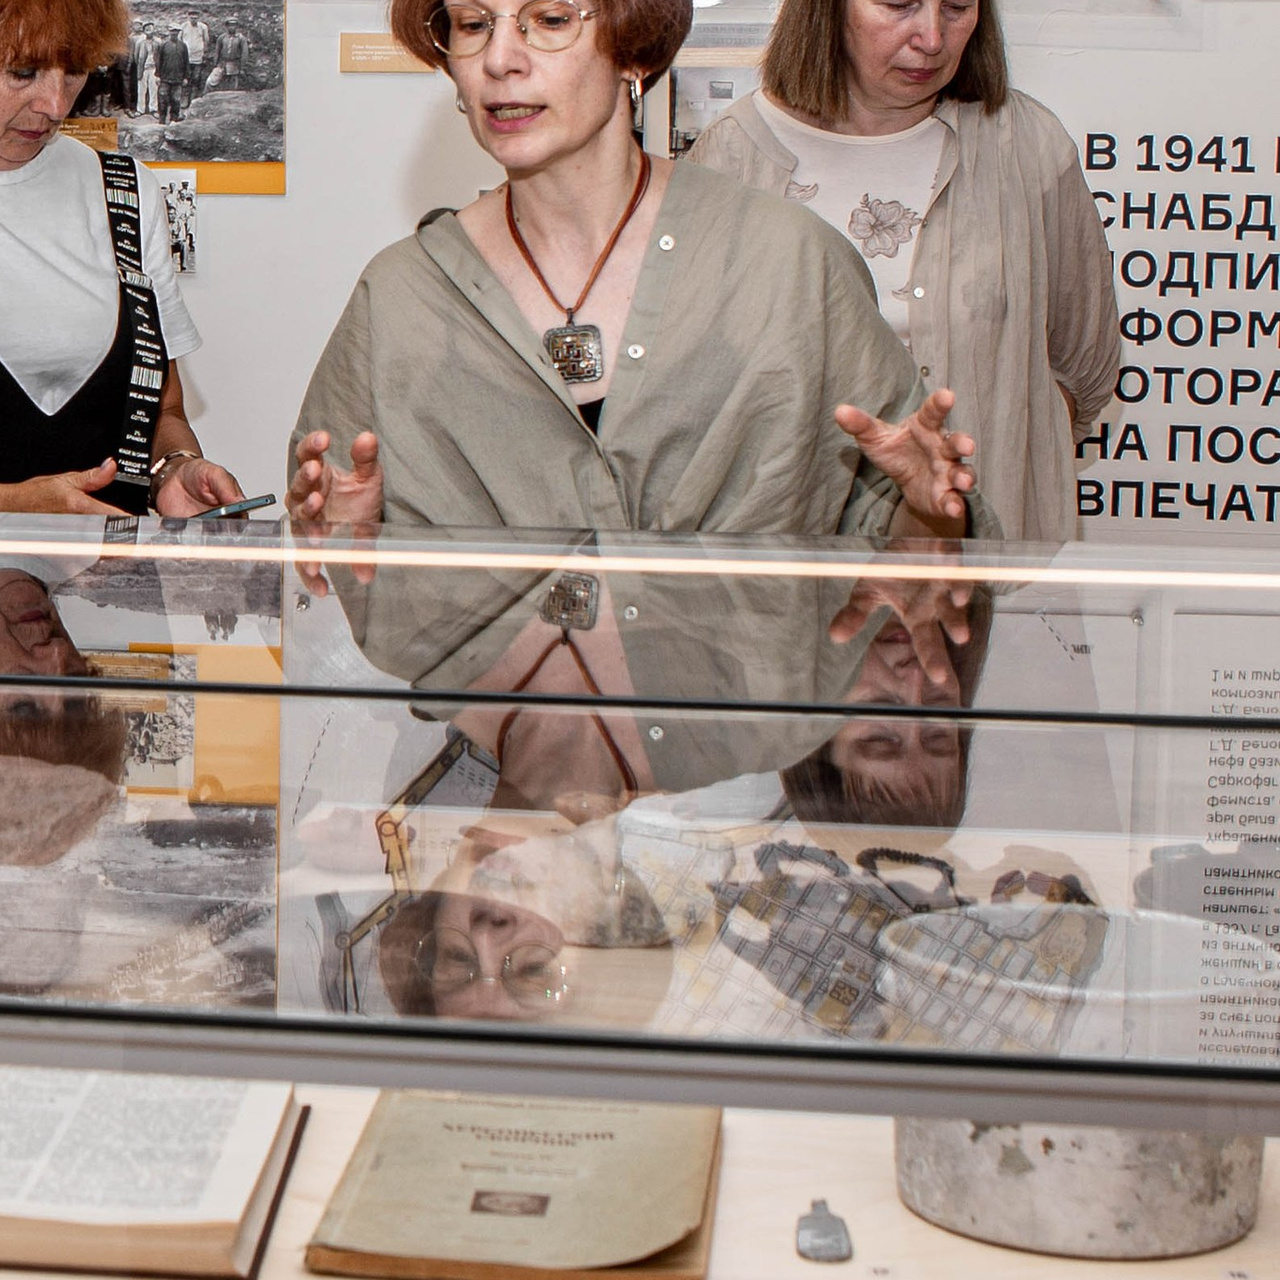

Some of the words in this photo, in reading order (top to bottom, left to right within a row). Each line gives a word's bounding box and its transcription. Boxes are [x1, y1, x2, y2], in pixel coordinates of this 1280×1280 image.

[1086, 133, 1117, 170] В
[1136, 135, 1256, 173] 1941
[1075, 422, 1149, 461] НА
